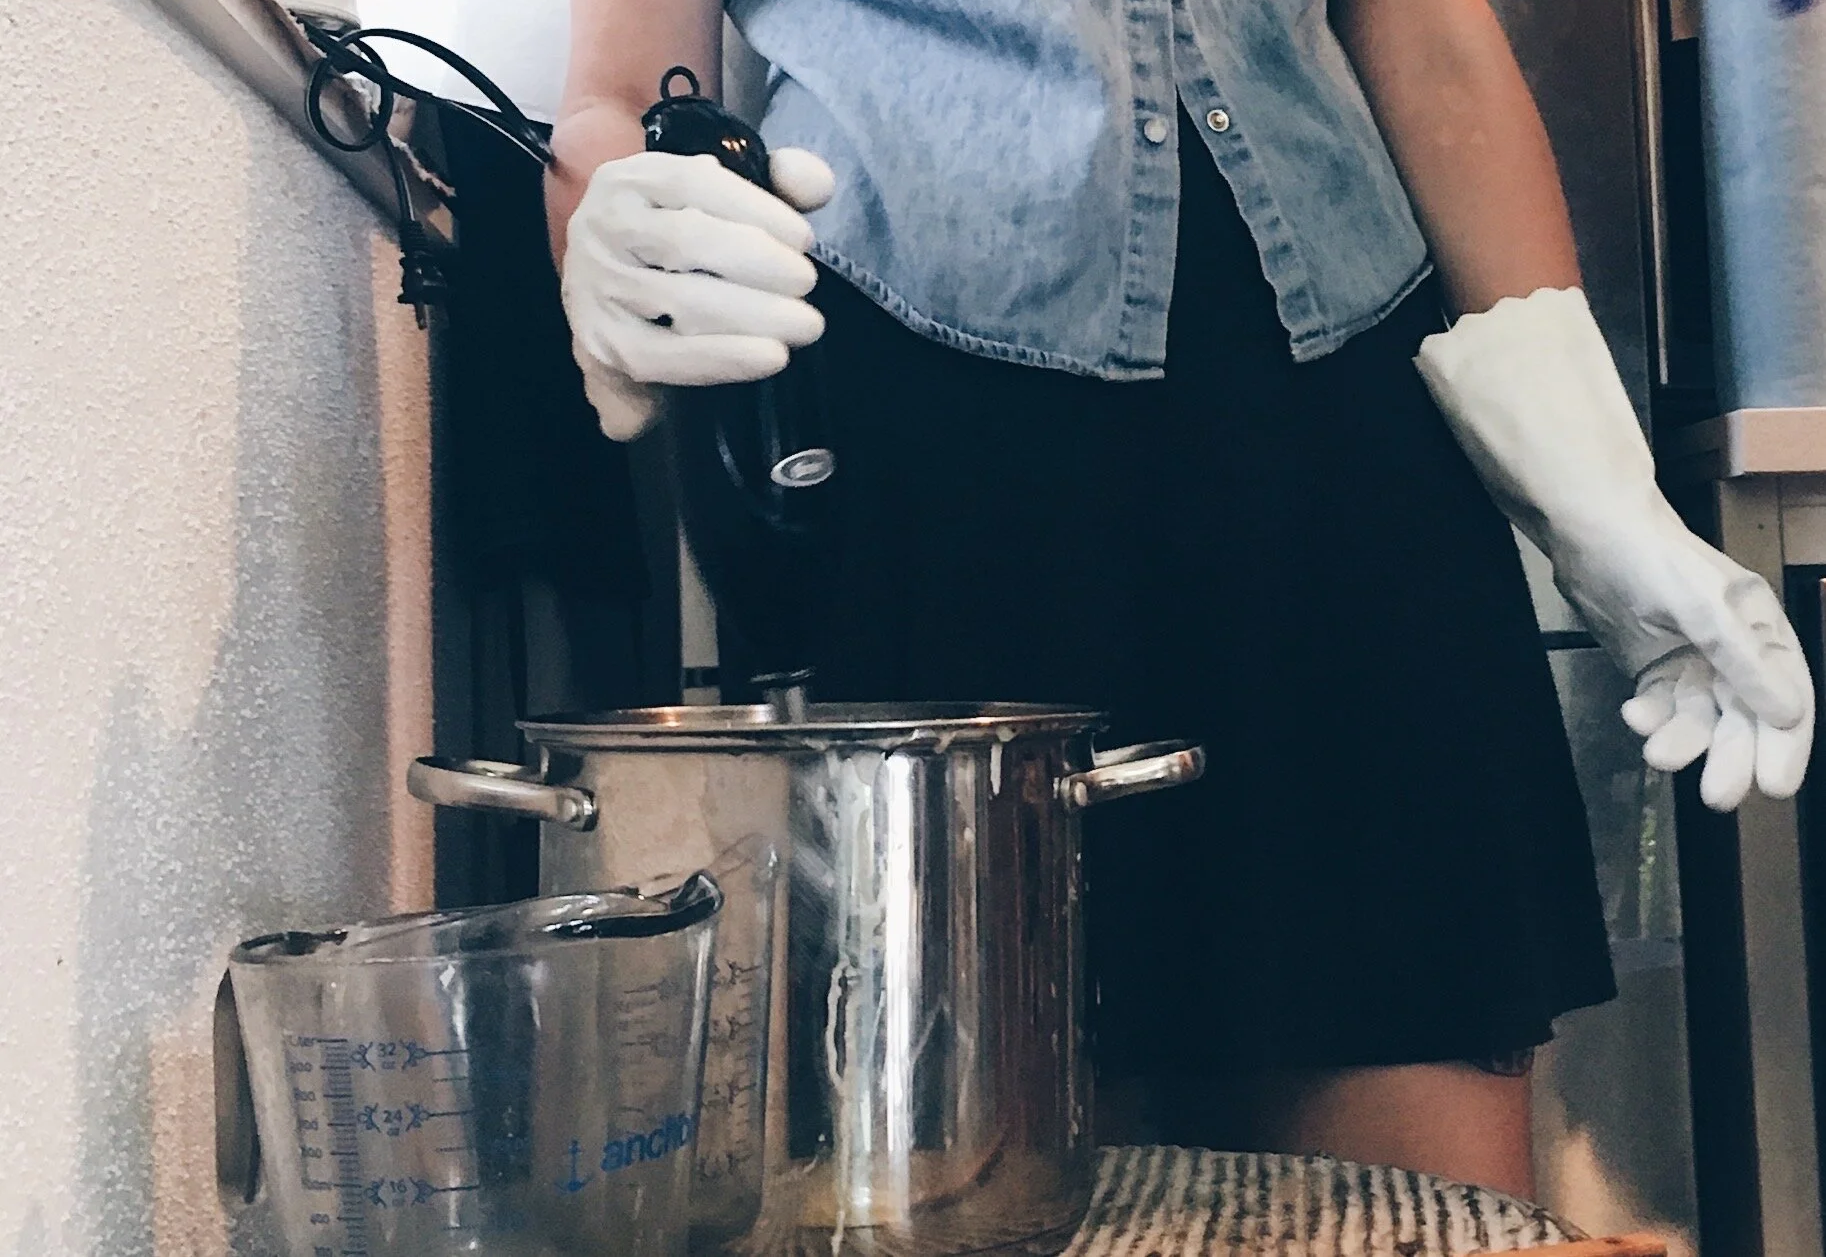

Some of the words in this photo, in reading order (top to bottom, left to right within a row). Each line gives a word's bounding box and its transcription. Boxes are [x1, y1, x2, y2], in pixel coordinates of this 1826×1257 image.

[378, 1042, 396, 1057] 32
[383, 1109, 403, 1123] 24
[389, 1179, 407, 1194] 16
